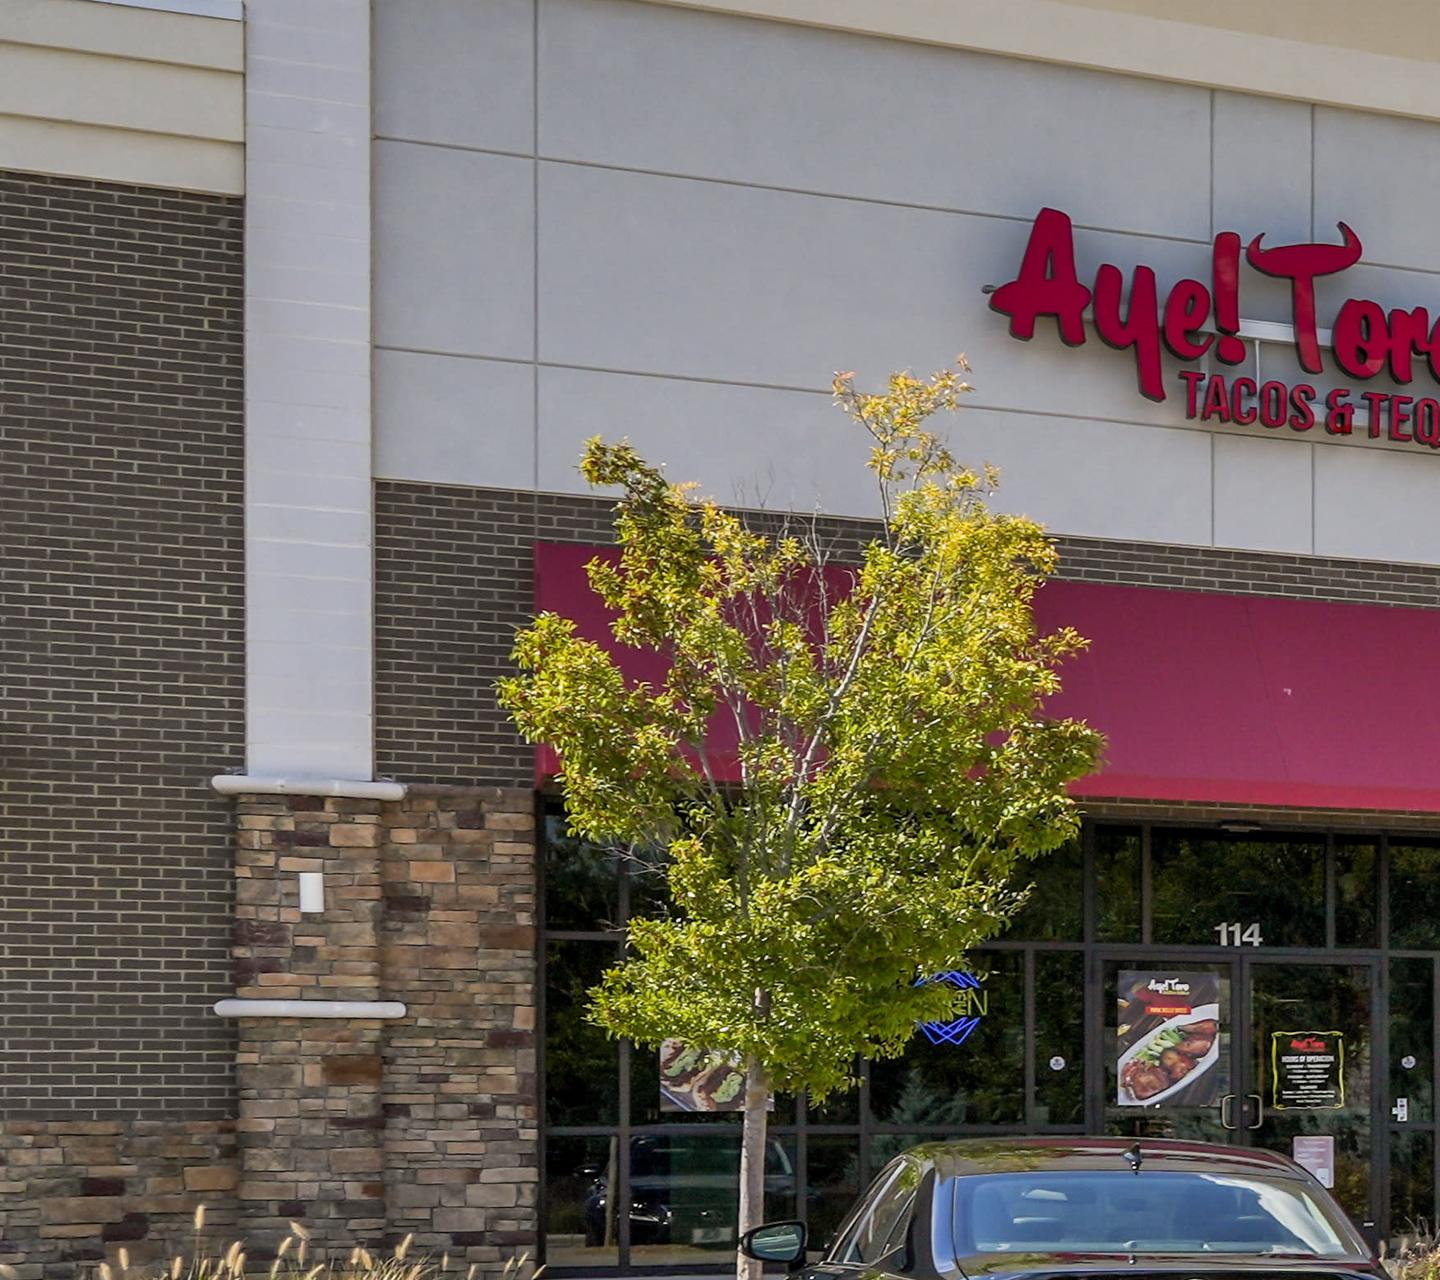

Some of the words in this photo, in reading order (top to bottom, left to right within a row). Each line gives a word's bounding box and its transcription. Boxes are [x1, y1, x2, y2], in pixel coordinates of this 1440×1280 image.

[990, 207, 1247, 402] Aye!
[1178, 370, 1316, 432] TACOS
[1325, 388, 1355, 435] &
[1213, 922, 1264, 947] 114
